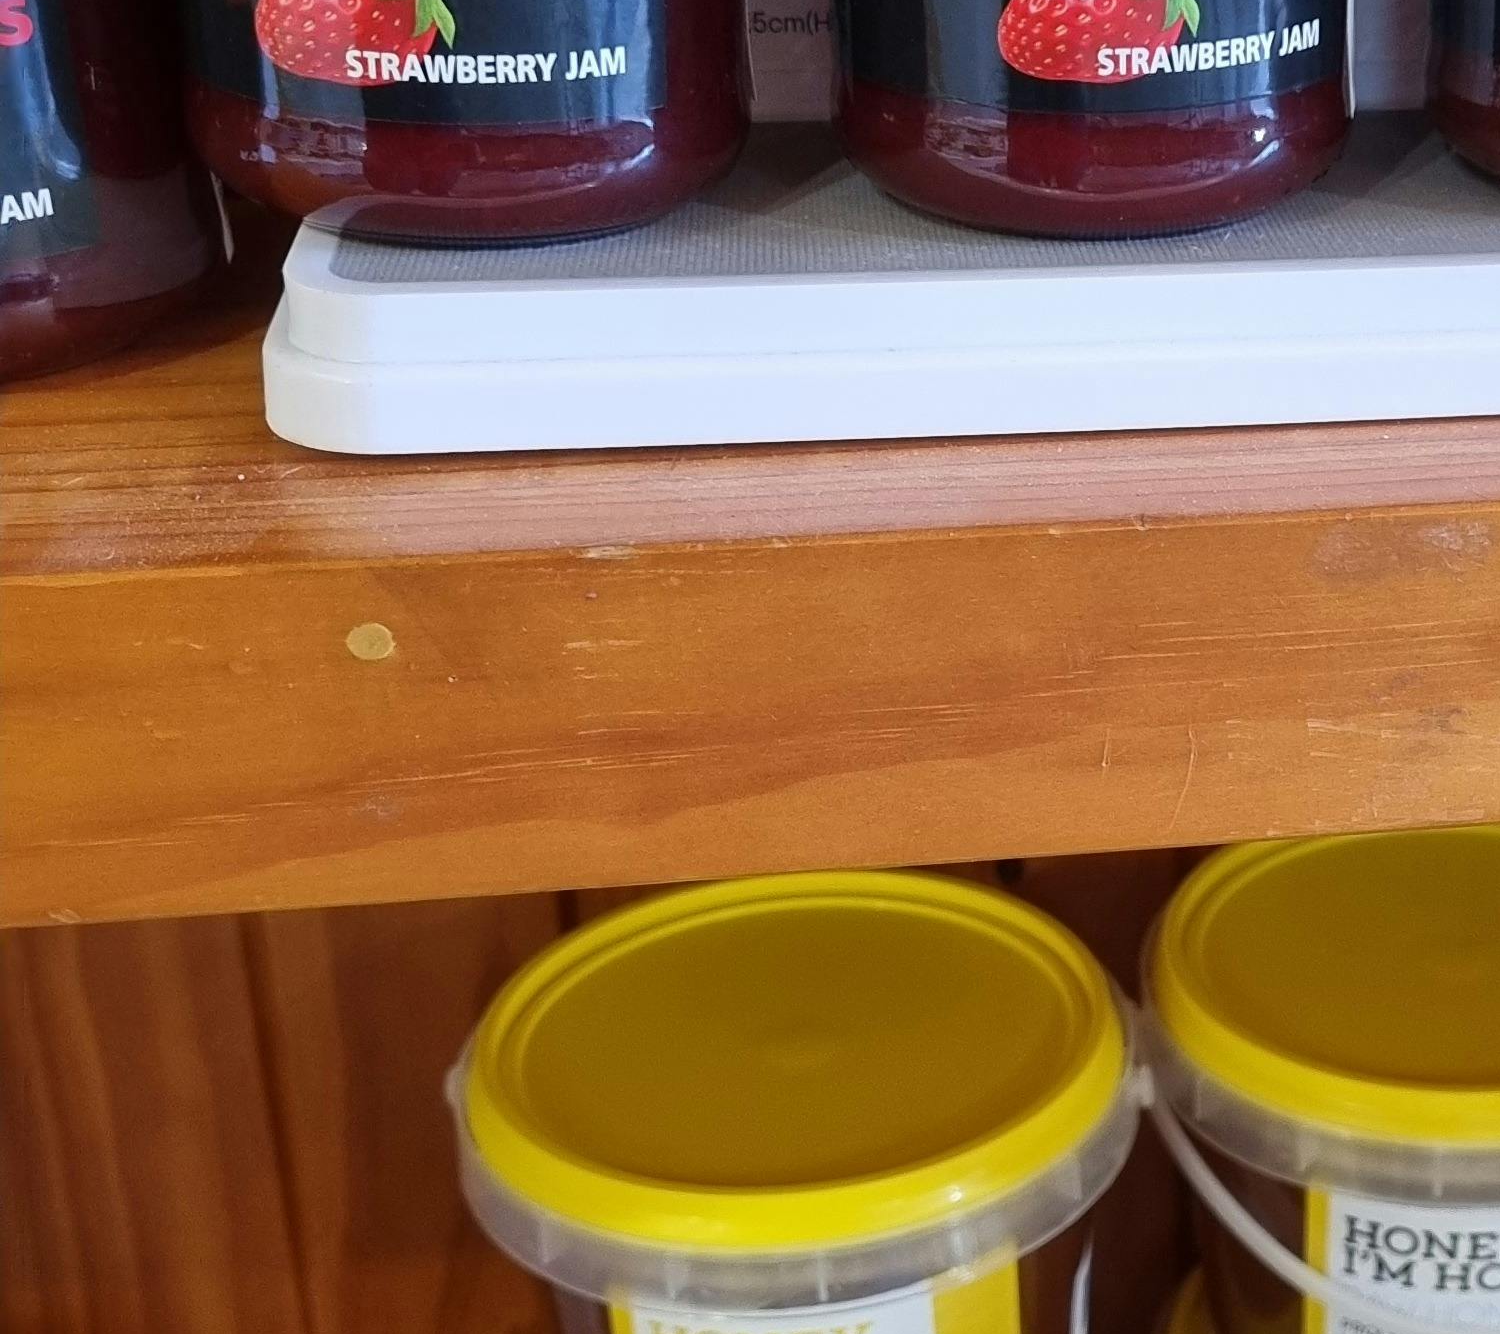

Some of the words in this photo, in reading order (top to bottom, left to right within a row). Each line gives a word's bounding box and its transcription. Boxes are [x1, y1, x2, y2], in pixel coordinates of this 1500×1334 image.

[345, 50, 557, 84] STRAWBERRY
[565, 46, 627, 81] JAM
[1097, 30, 1275, 77] STRAWBERRY
[1279, 19, 1321, 58] JAM
[0, 188, 54, 226] AM
[1342, 1242, 1416, 1289] I'M
